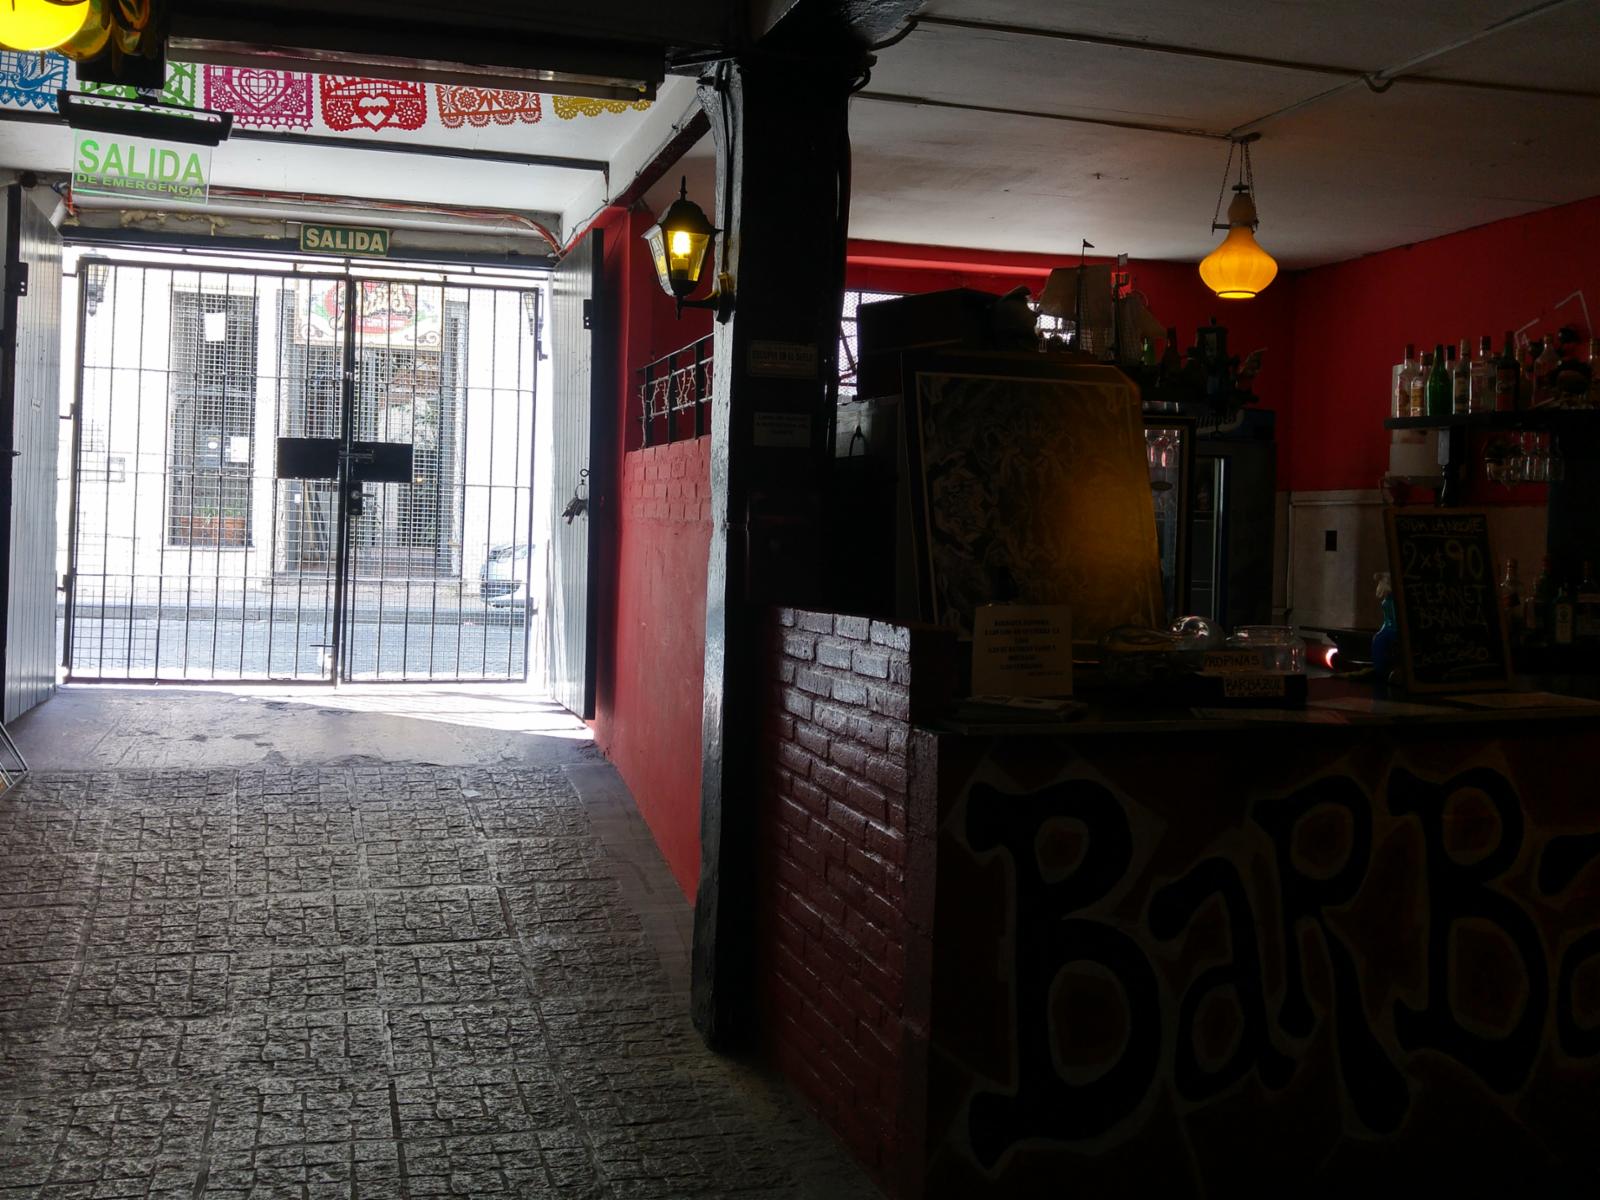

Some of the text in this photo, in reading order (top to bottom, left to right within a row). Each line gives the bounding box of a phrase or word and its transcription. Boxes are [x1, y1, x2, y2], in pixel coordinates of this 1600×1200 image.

[78, 138, 205, 186] SALIDA
[76, 173, 203, 196] DE EMERGENCIA
[306, 227, 384, 252] SALIDA
[1408, 583, 1487, 606] FERNET
